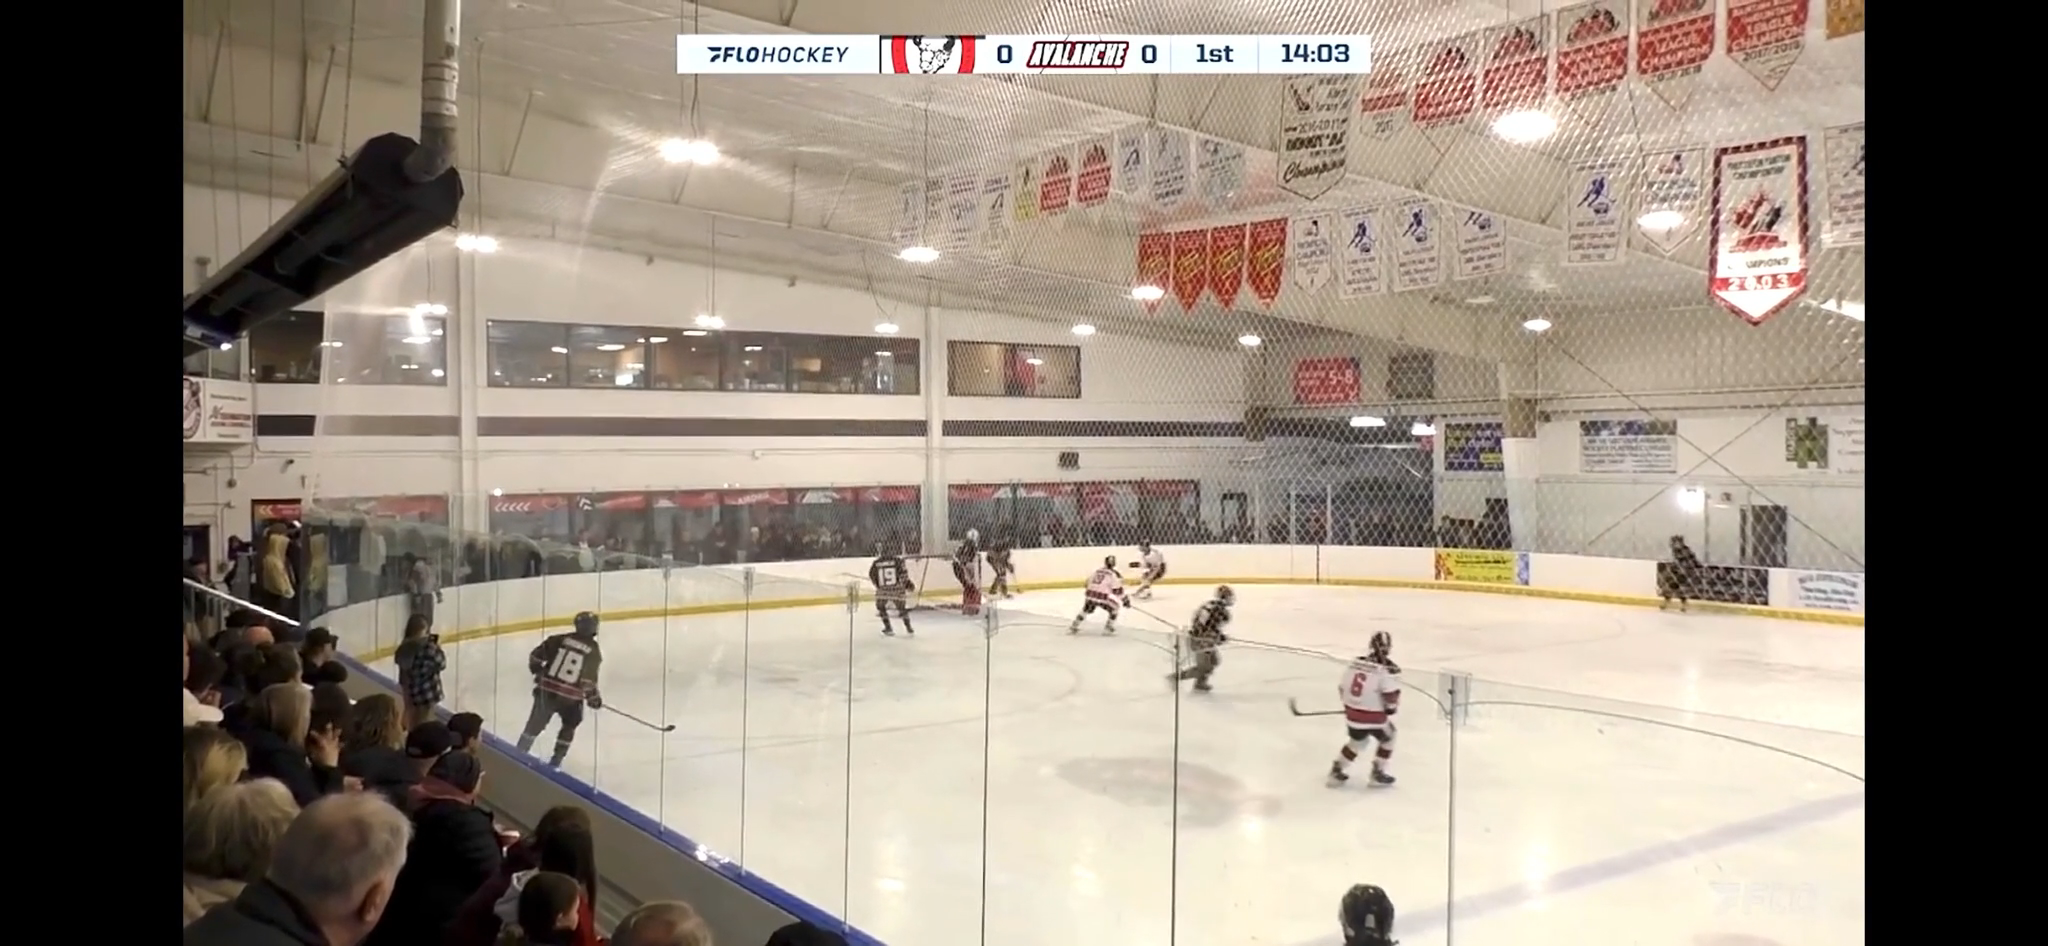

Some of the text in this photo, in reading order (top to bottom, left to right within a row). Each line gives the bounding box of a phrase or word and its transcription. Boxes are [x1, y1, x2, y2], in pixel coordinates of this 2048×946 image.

[1728, 273, 1790, 292] 2003
[877, 566, 898, 587] 19
[547, 647, 585, 684] 18
[1350, 672, 1368, 698] 6
